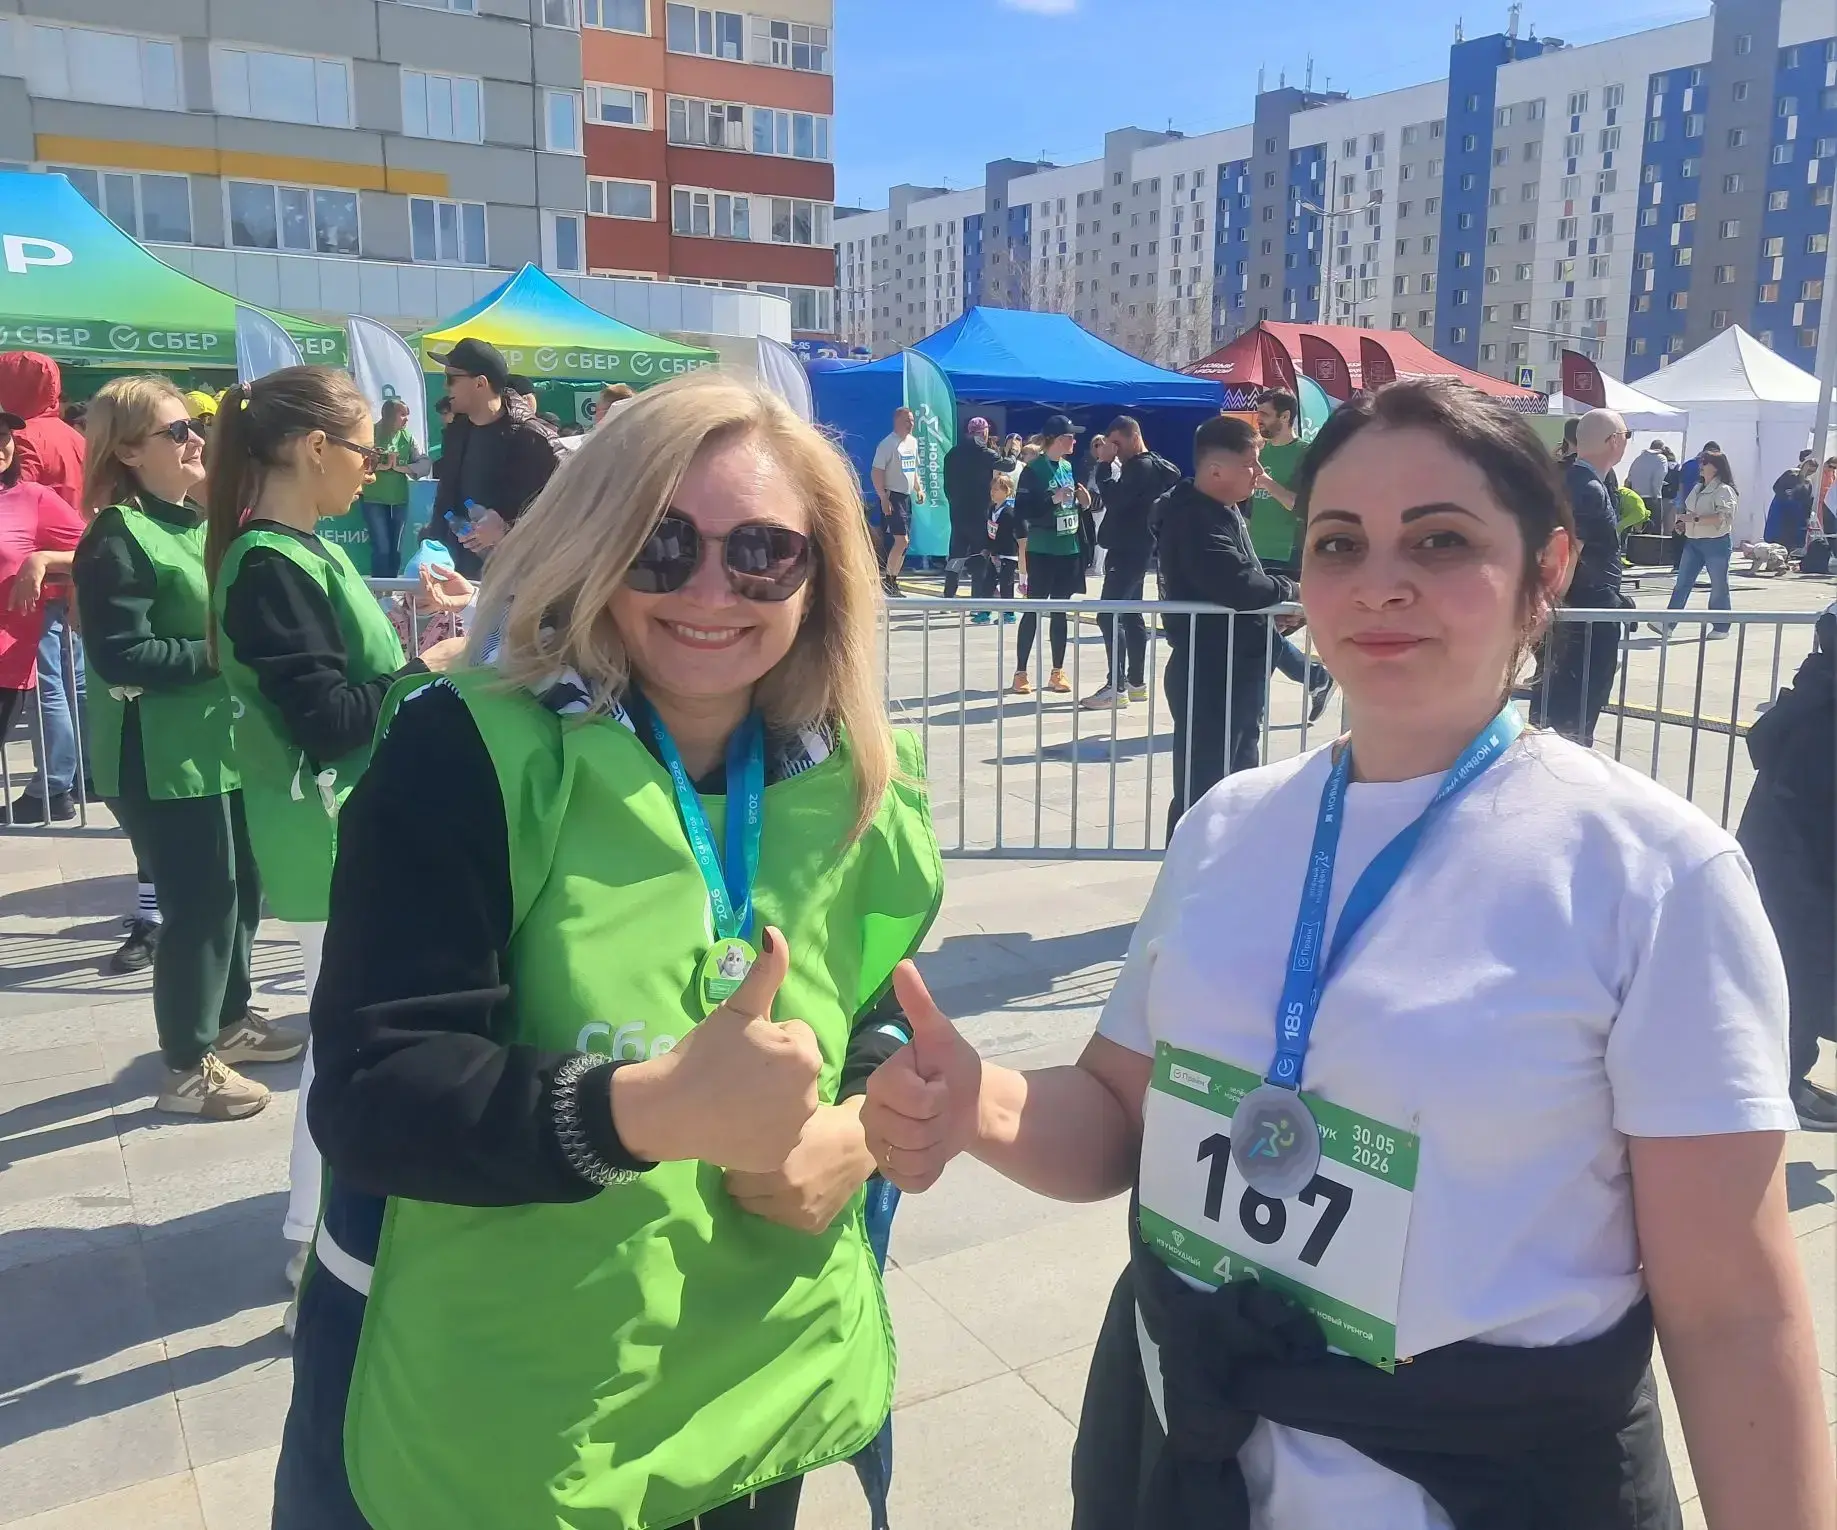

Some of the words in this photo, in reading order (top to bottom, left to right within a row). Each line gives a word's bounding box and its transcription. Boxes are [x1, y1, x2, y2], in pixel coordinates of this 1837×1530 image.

[16, 326, 91, 346] СБЕР
[147, 331, 218, 351] СБЕР
[292, 337, 336, 355] ЕР
[564, 352, 621, 370] СБЕР
[671, 760, 687, 792] 2026
[1457, 744, 1491, 779] НОВЫЙ
[748, 793, 758, 825] 2026
[711, 888, 728, 921] 2026
[1284, 1002, 1303, 1040] 185
[576, 1020, 678, 1062] Сбе
[1352, 1124, 1395, 1155] 30.05
[1352, 1145, 1389, 1174] 2026
[1316, 1310, 1343, 1328] НОВЫЙ
[1343, 1320, 1375, 1343] УРЕНГОЙ
